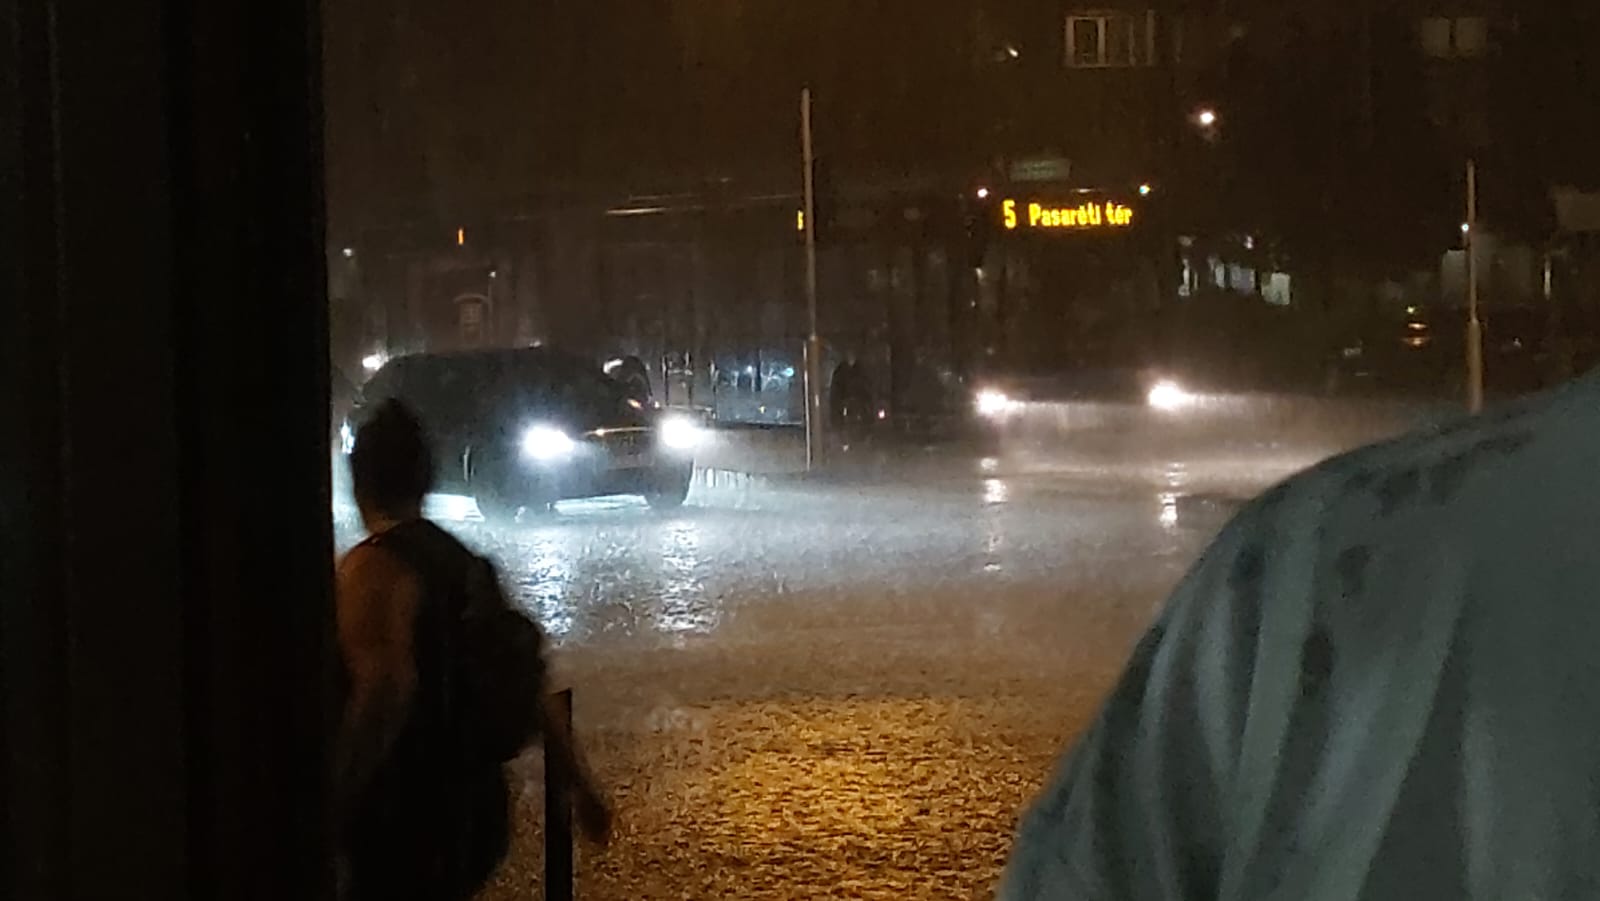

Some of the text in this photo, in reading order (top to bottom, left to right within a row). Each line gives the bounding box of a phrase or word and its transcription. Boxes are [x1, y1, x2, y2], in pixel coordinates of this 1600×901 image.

[1003, 199, 1132, 229] 5 Pasaréti tér
